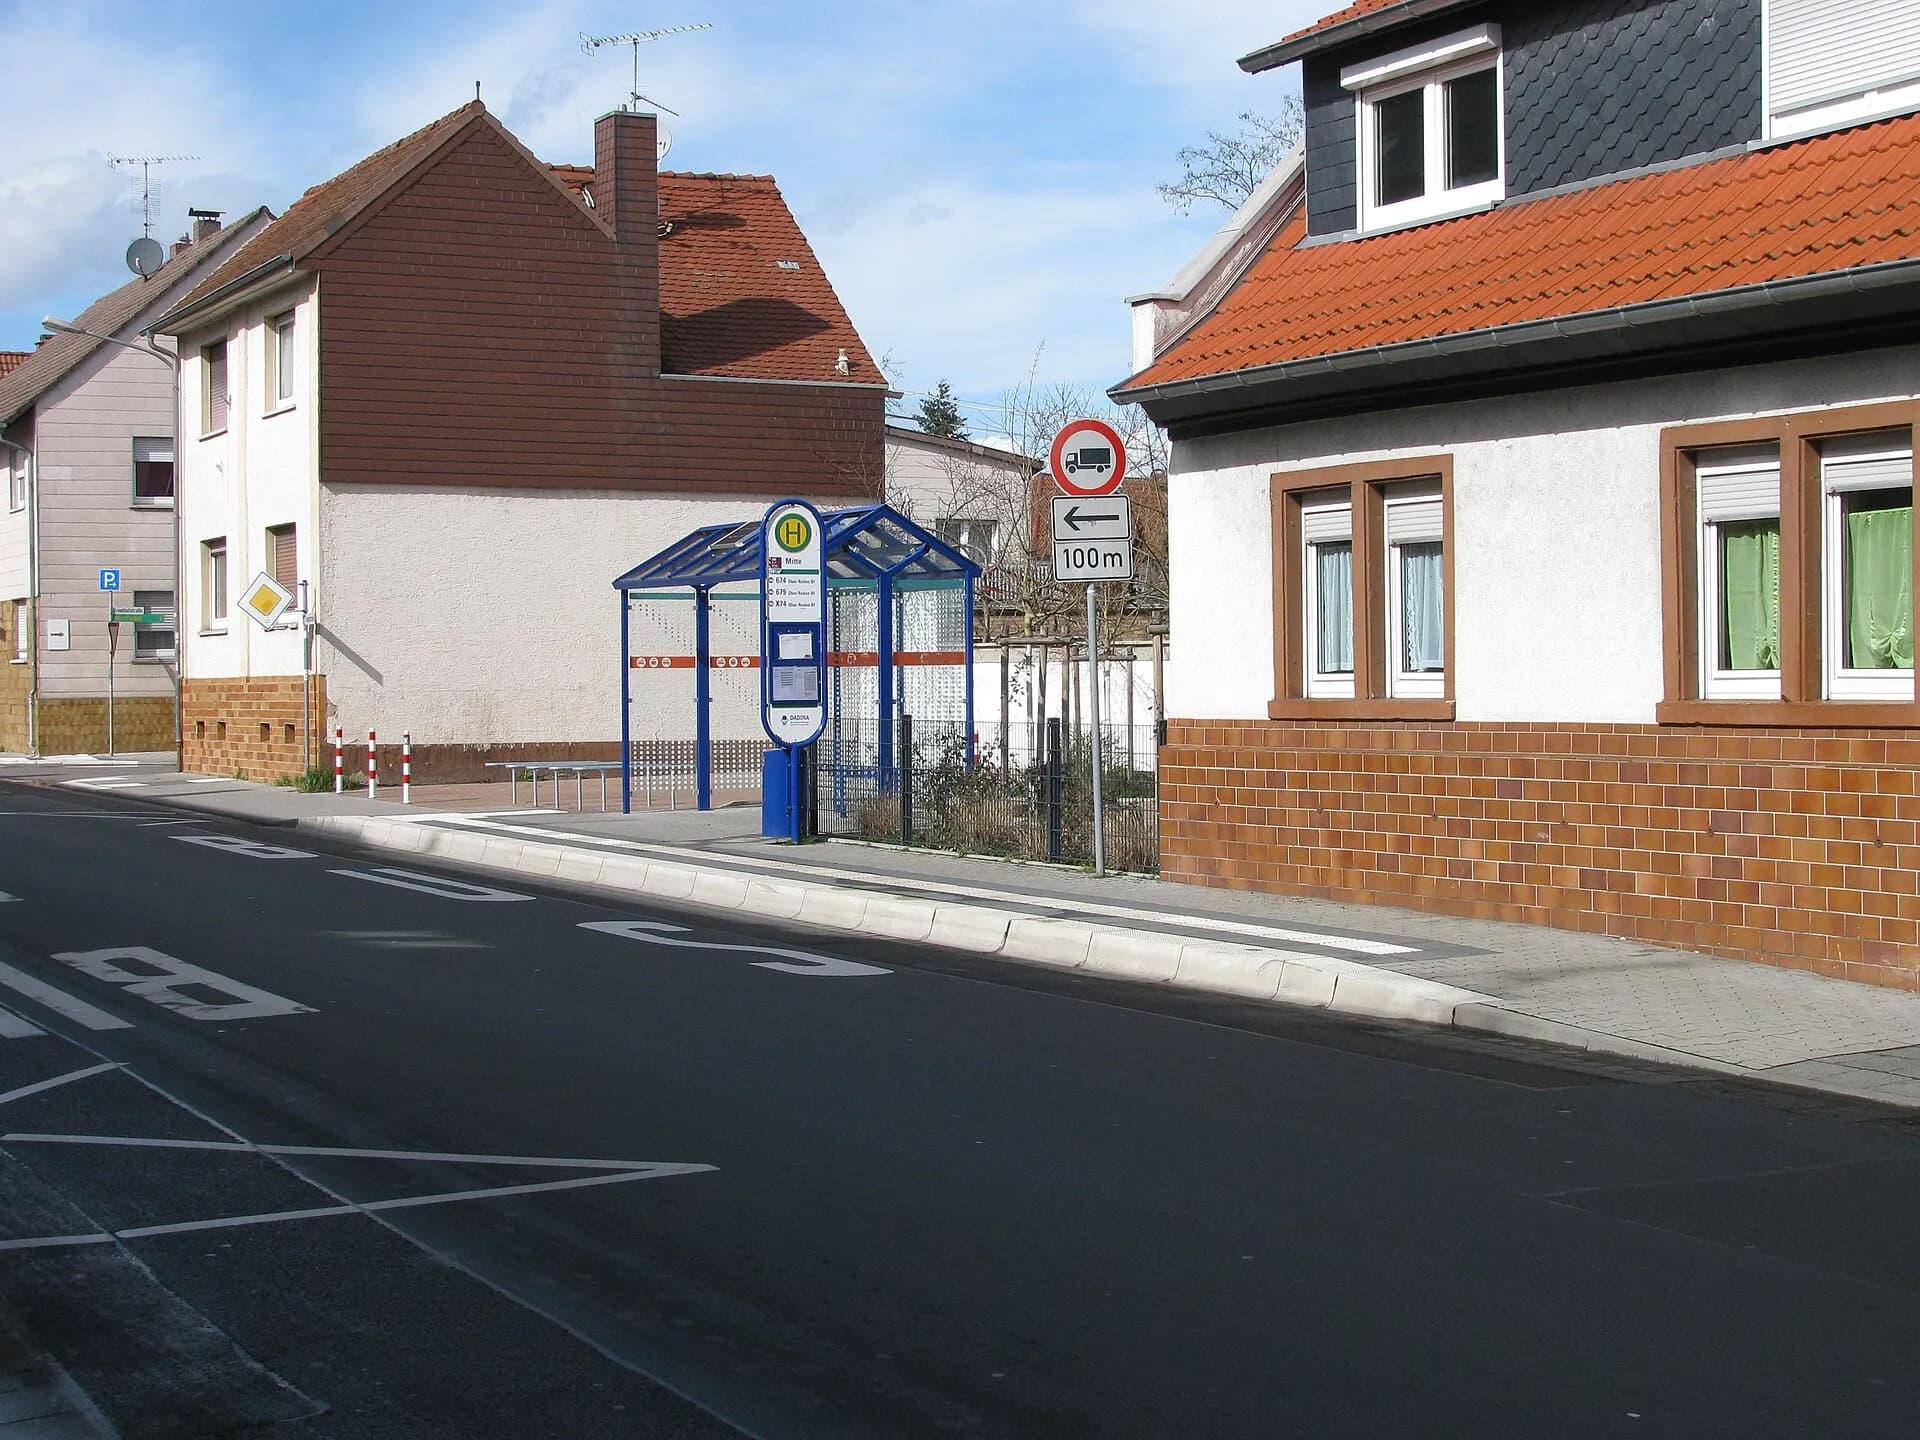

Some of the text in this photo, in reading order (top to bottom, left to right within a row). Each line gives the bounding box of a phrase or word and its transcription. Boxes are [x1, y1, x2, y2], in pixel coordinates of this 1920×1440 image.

[785, 522, 800, 544] H
[785, 557, 802, 565] Mitte
[104, 571, 115, 588] P
[775, 588, 787, 596] 679
